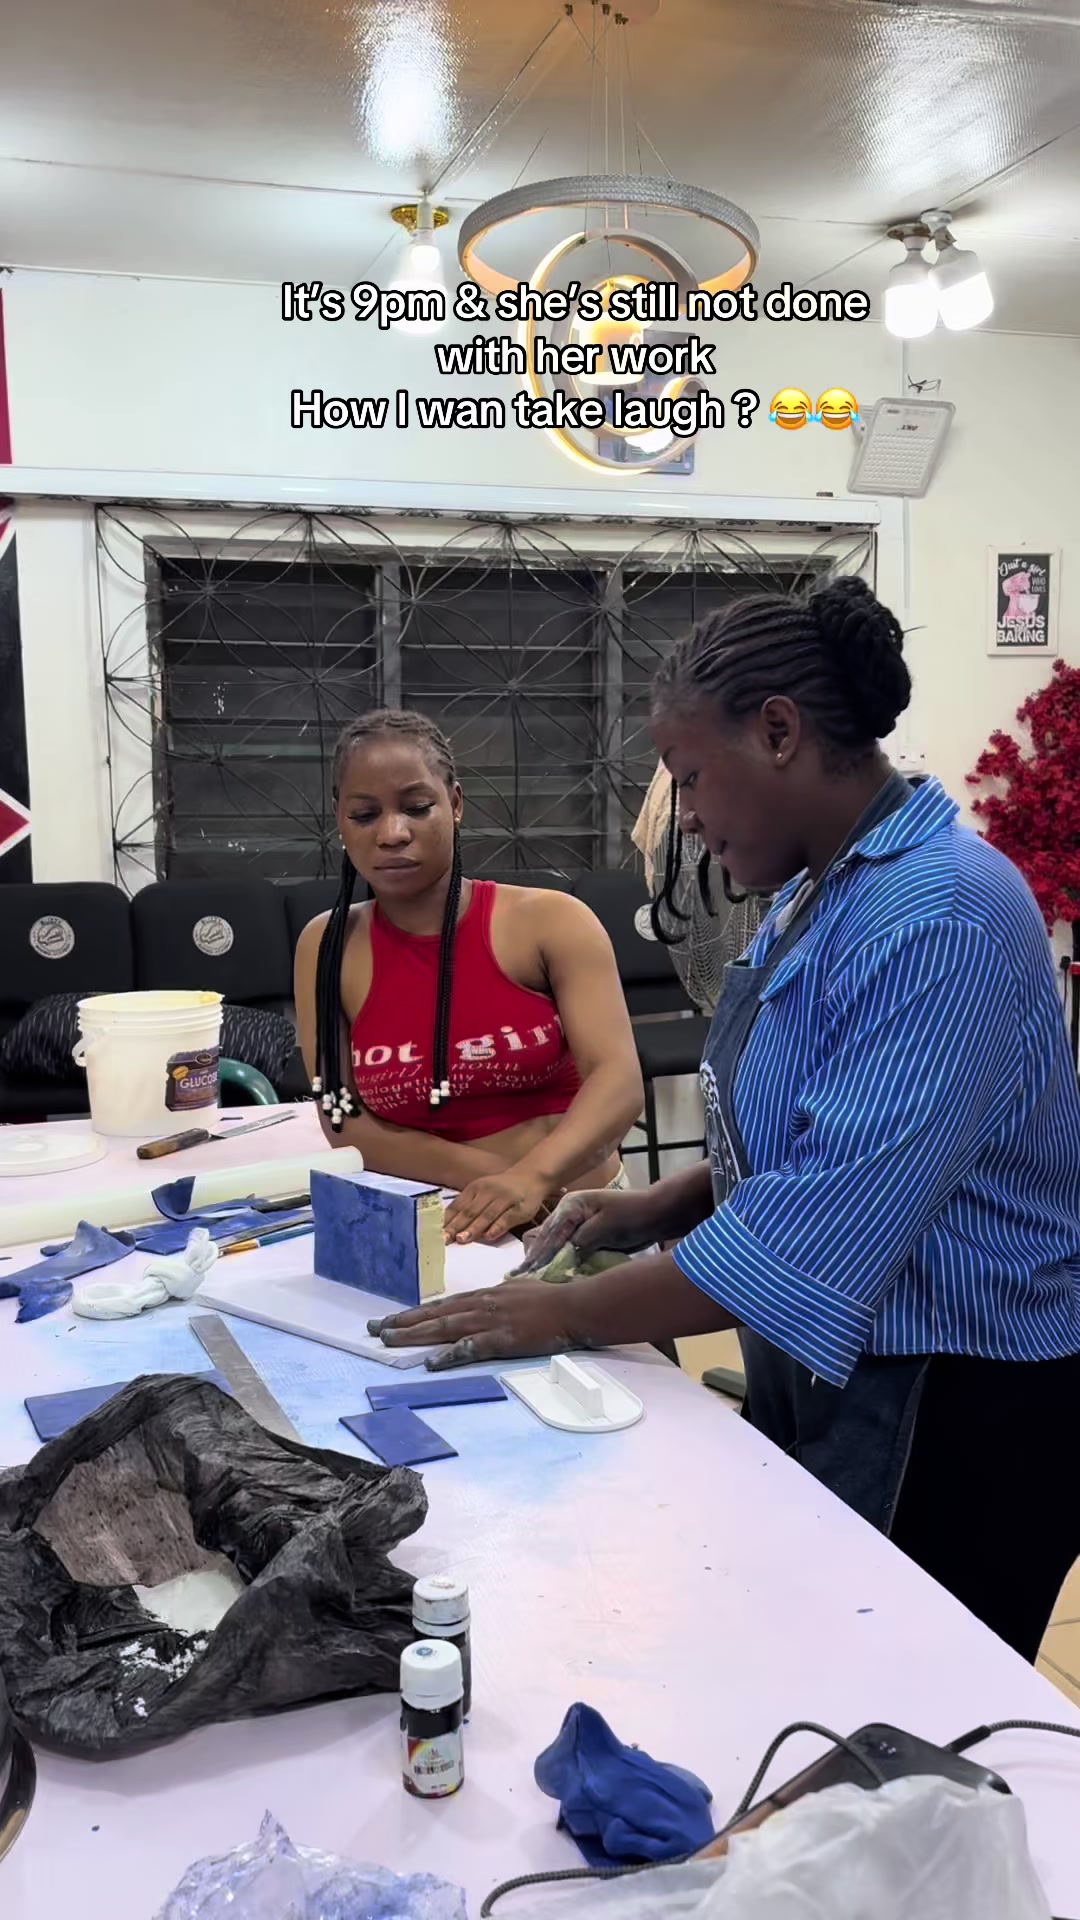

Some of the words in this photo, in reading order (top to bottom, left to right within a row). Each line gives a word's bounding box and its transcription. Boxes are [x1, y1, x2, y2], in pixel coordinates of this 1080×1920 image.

[997, 558, 1021, 576] Just
[997, 614, 1046, 629] JESUS
[996, 629, 1045, 643] BAKING
